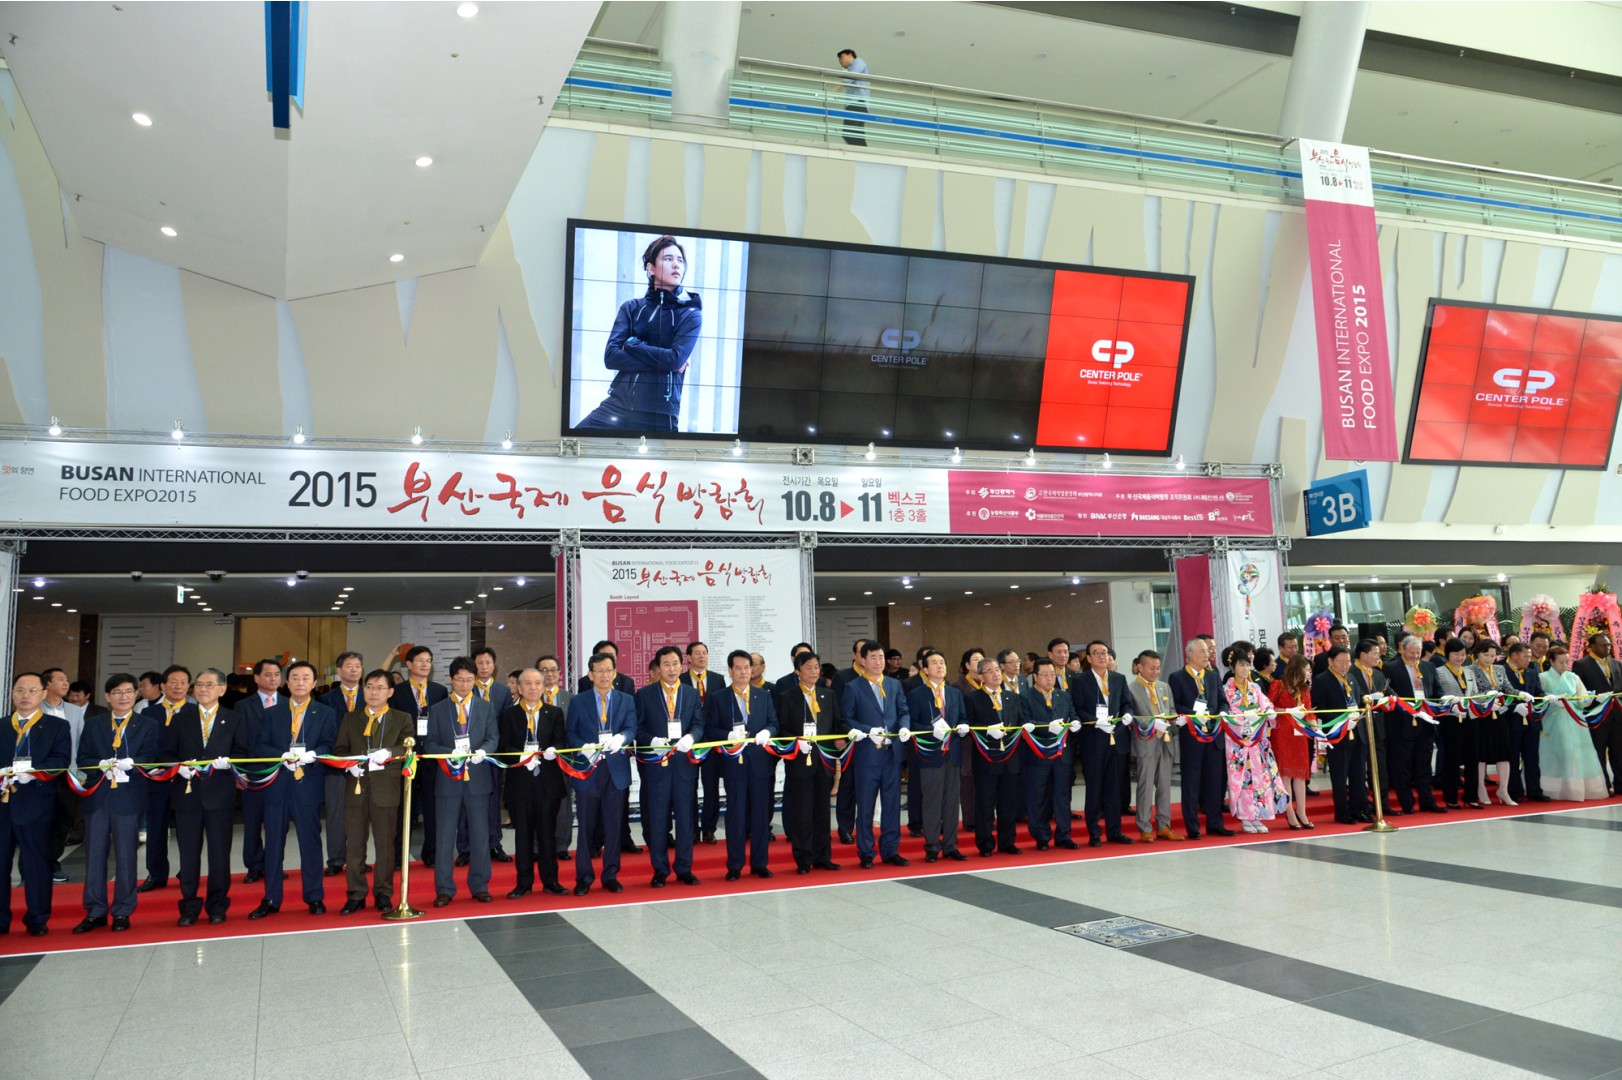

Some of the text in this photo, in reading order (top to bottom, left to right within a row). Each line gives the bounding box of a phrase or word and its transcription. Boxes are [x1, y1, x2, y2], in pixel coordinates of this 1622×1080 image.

[1320, 175, 1338, 187] 10.8
[1344, 178, 1352, 189] 11
[1328, 239, 1355, 428] BUSAN INTERNATIONAL
[871, 354, 927, 365] CENTER POLE
[1352, 284, 1376, 428] FOOD EXPO 2015
[1080, 369, 1141, 382] CENTER POLE
[1475, 392, 1564, 406] CENTER POLE
[60, 465, 266, 485] BUSAN INTERNATIONAL
[782, 476, 882, 488] 전시기간 목요일 일요일
[59, 487, 197, 503] FOOD EXPO2015
[288, 470, 377, 508] 2015
[780, 490, 882, 522] 10.8 11
[887, 491, 927, 507] 벡스코
[888, 509, 927, 523] 1층 3홀
[1322, 492, 1357, 527] 3B
[612, 568, 637, 580] 2015
